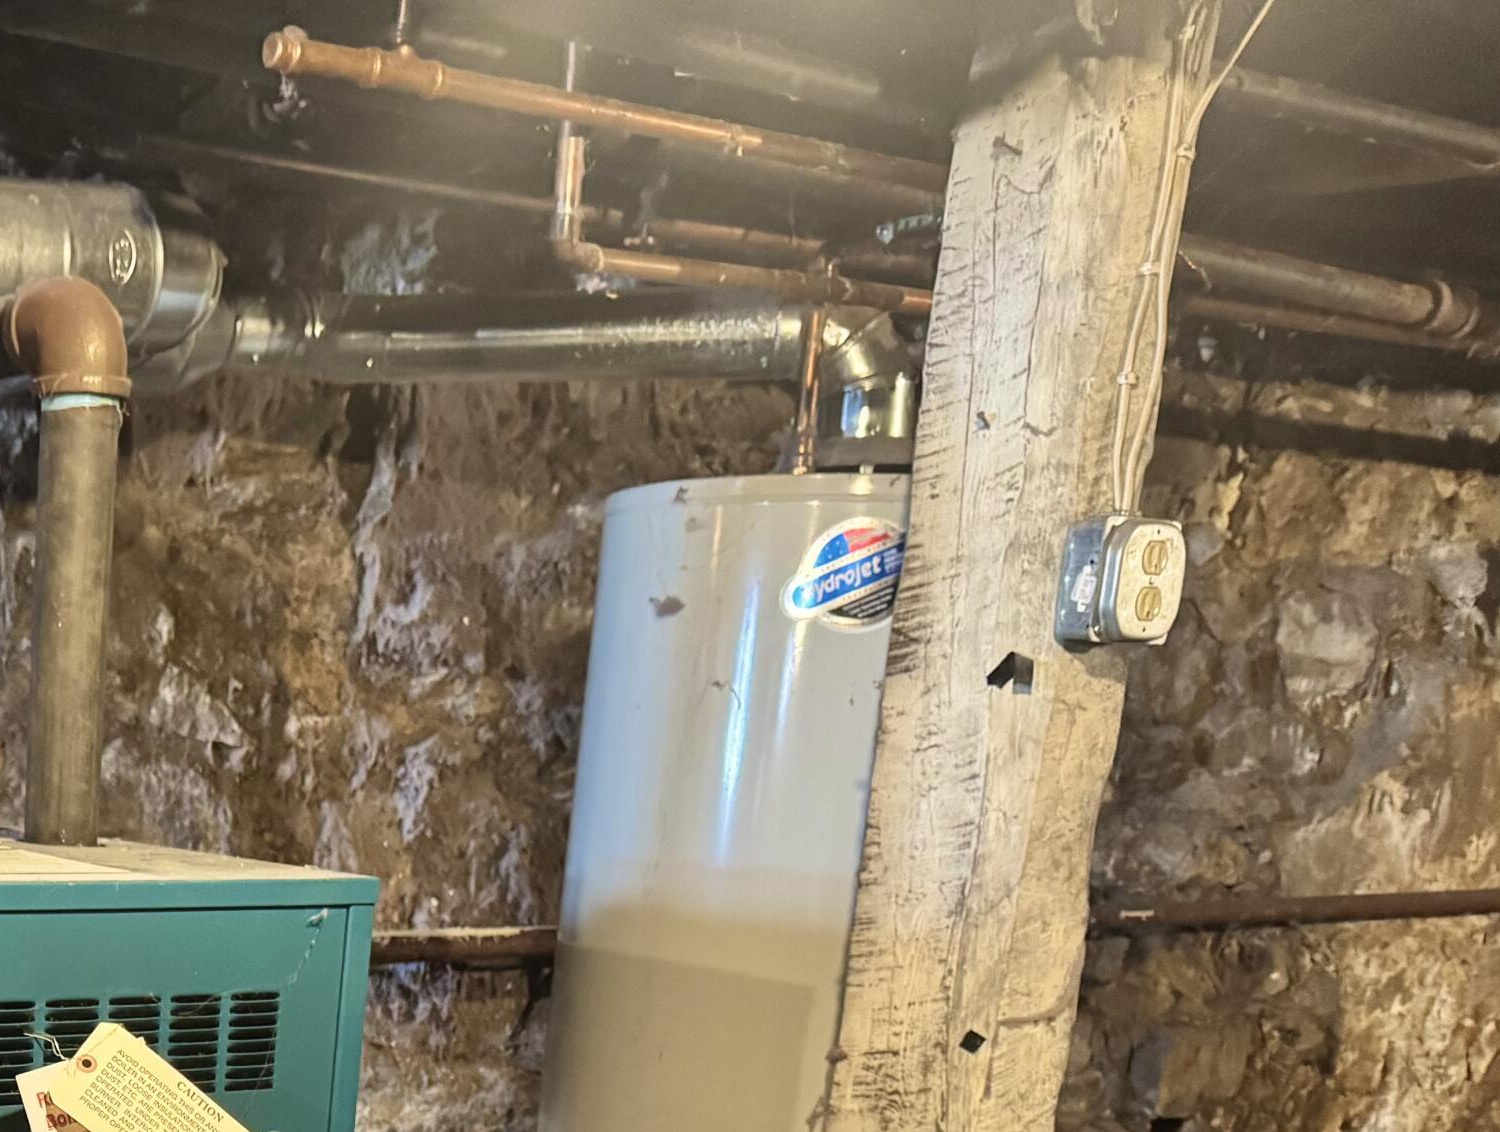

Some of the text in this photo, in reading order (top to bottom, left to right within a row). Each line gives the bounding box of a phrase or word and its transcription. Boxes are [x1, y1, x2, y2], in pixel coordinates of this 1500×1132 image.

[111, 1055, 138, 1078] BOILER
[137, 1076, 147, 1085] IN
[145, 1083, 157, 1094] AN
[116, 1049, 139, 1068] AVOID
[138, 1065, 178, 1101] OPERATING
[178, 1097, 195, 1114] THIS
[194, 1112, 206, 1125] OR
[128, 1078, 153, 1101] LOOSE
[79, 1095, 110, 1121] PROPER
[84, 1089, 118, 1117] CLEANED
[118, 1116, 135, 1131] AND
[90, 1081, 121, 1109] BURNER
[95, 1075, 134, 1107] OPERATED
[134, 1106, 160, 1130] UNDER
[138, 1099, 154, 1113] ARE
[177, 1081, 224, 1123] CAUTION
